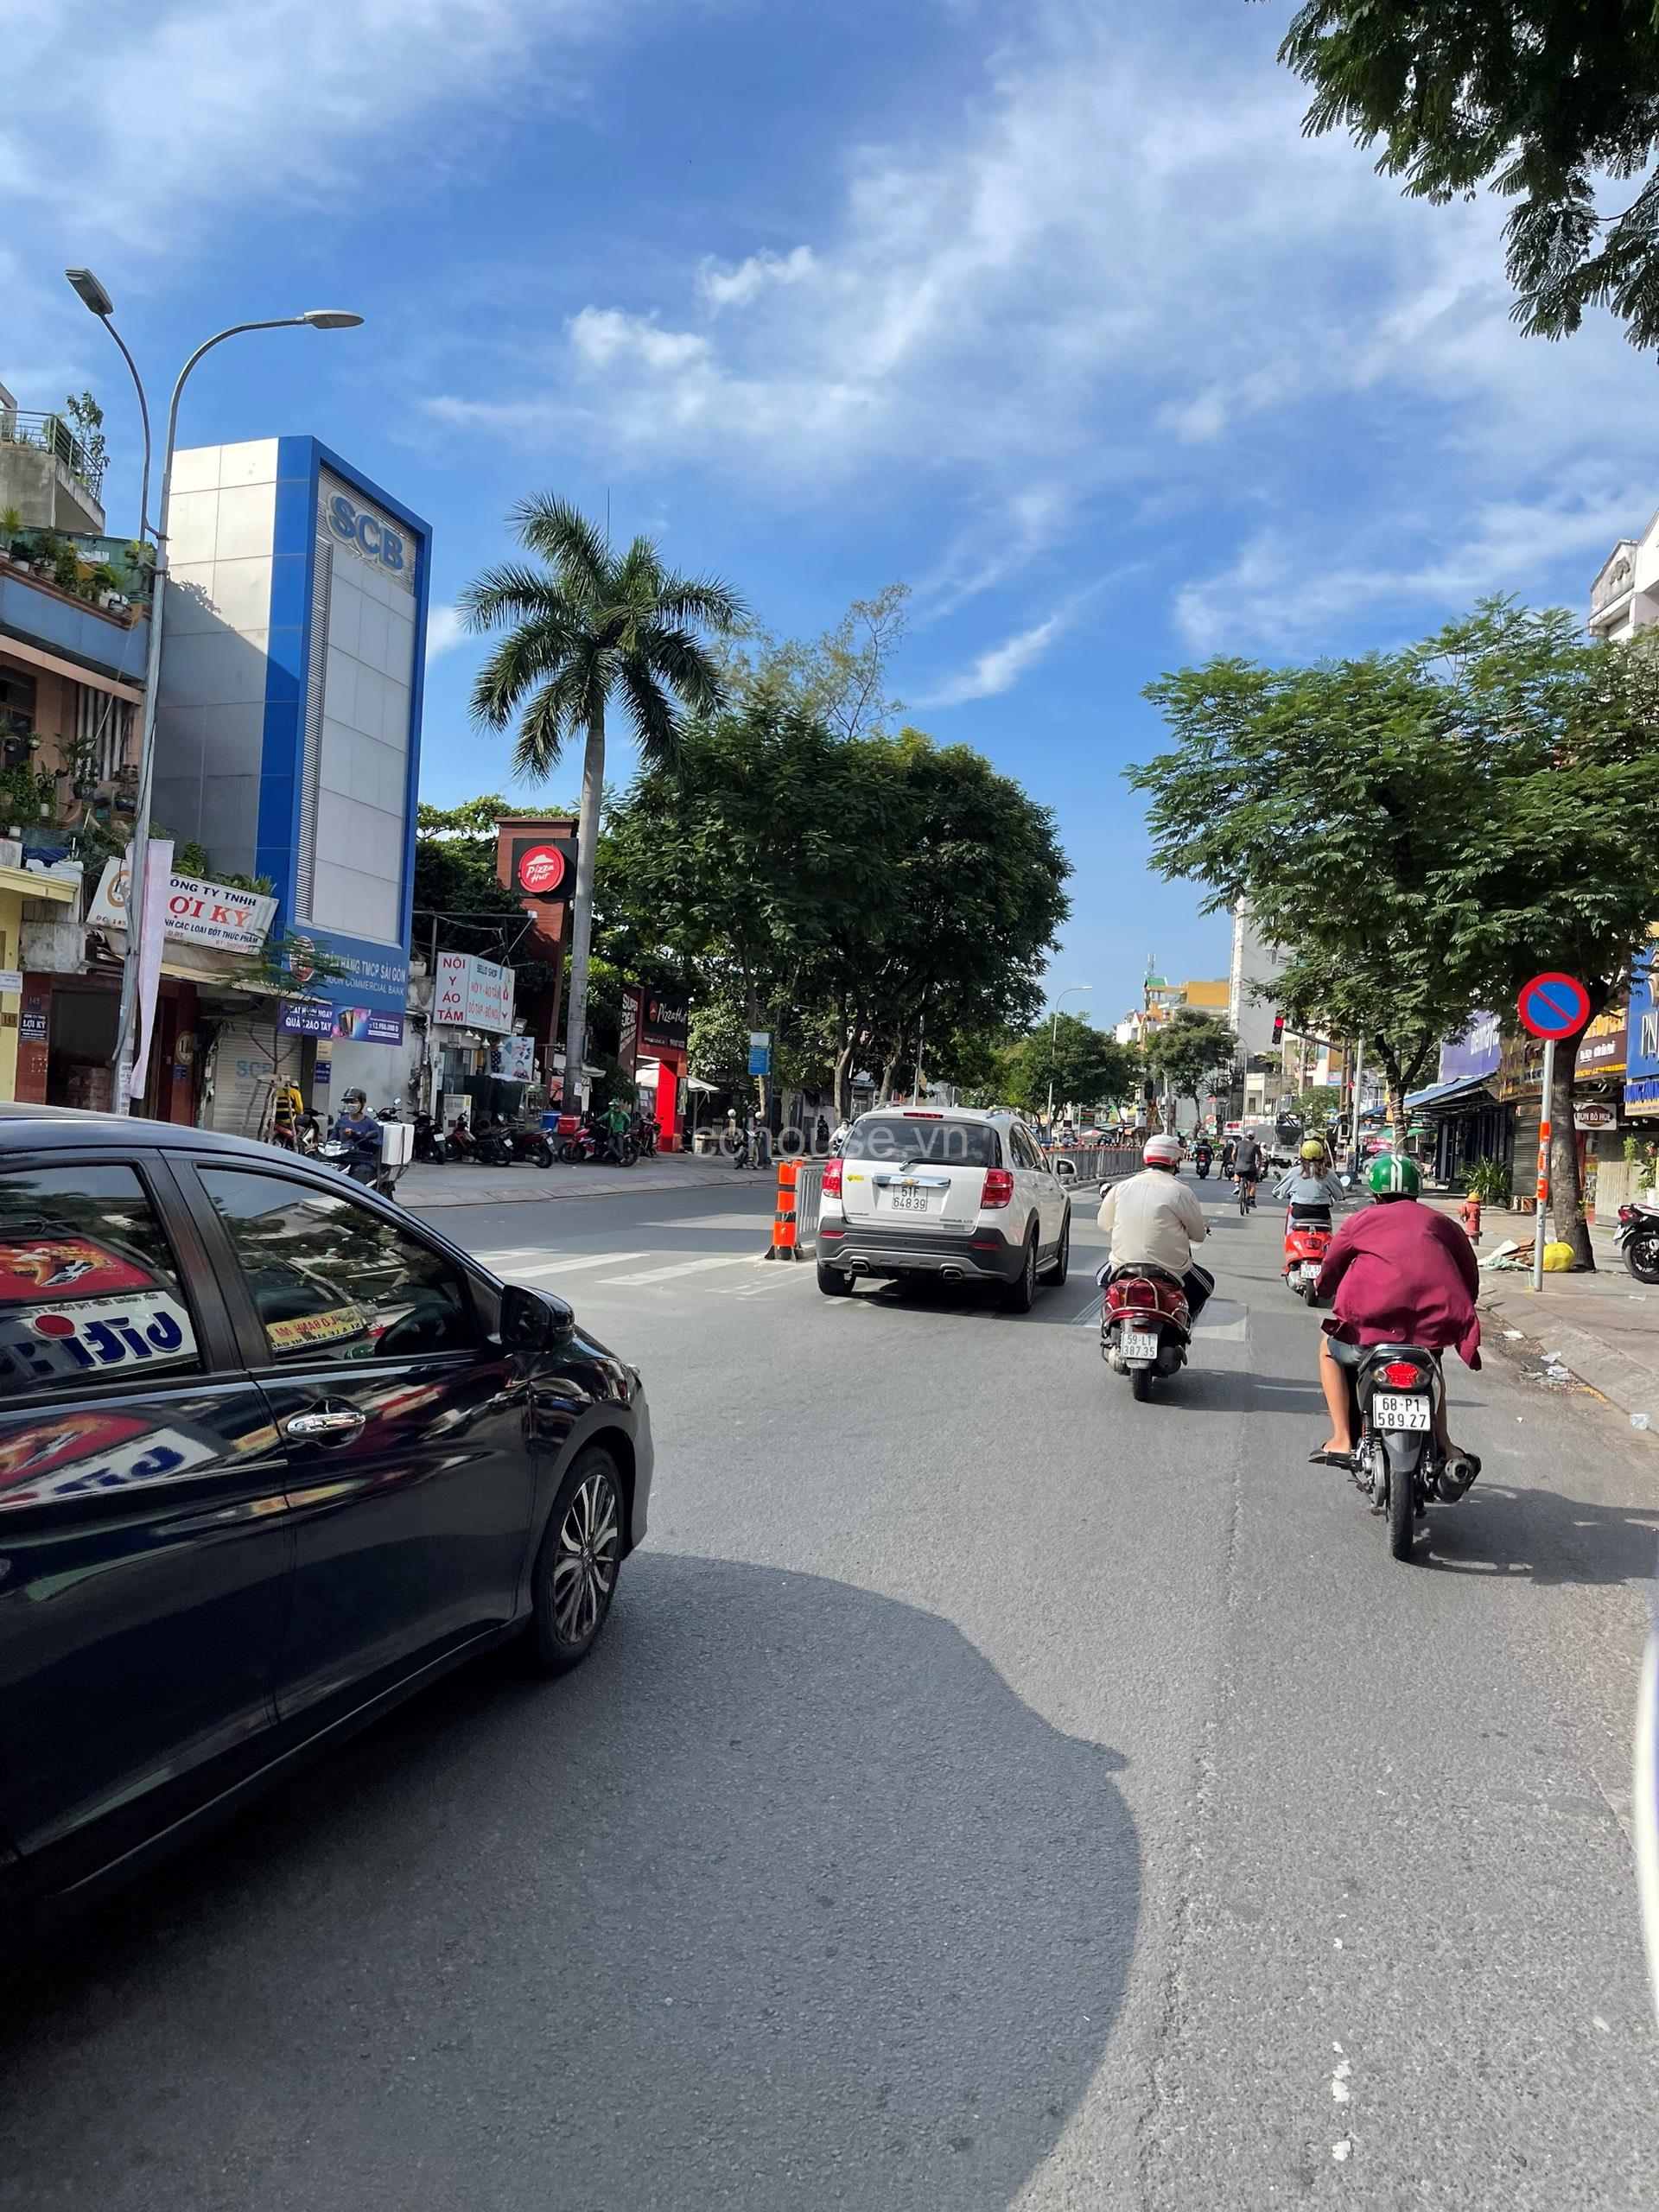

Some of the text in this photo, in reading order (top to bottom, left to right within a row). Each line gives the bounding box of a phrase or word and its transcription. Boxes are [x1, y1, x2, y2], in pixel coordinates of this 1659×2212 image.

[328, 495, 404, 570] SCB
[526, 864, 554, 879] Pizza
[531, 872, 550, 883] Hut
[169, 878, 257, 906] ÔNG TY TNHH
[168, 895, 253, 927] ỢI KÝ
[442, 956, 466, 970] NỘI
[362, 961, 380, 978] TMCP
[380, 963, 391, 981] SÀI
[391, 964, 406, 983] GÒN
[346, 977, 387, 993] COMMERCIAL
[387, 987, 404, 996] BANK
[448, 976, 457, 987] Y
[442, 990, 461, 1004] ÁO
[317, 1009, 333, 1019] NGAY
[437, 1005, 465, 1022] TẮM
[22, 1019, 47, 1029] LỢI KÝ
[285, 1015, 301, 1028] QUÀ
[320, 1021, 333, 1032] TAY
[1641, 1010, 1659, 1058] PN
[901, 1185, 920, 1198] 51F
[1382, 1397, 1420, 1412] 68-P1
[1378, 1412, 1427, 1428] 589.27
